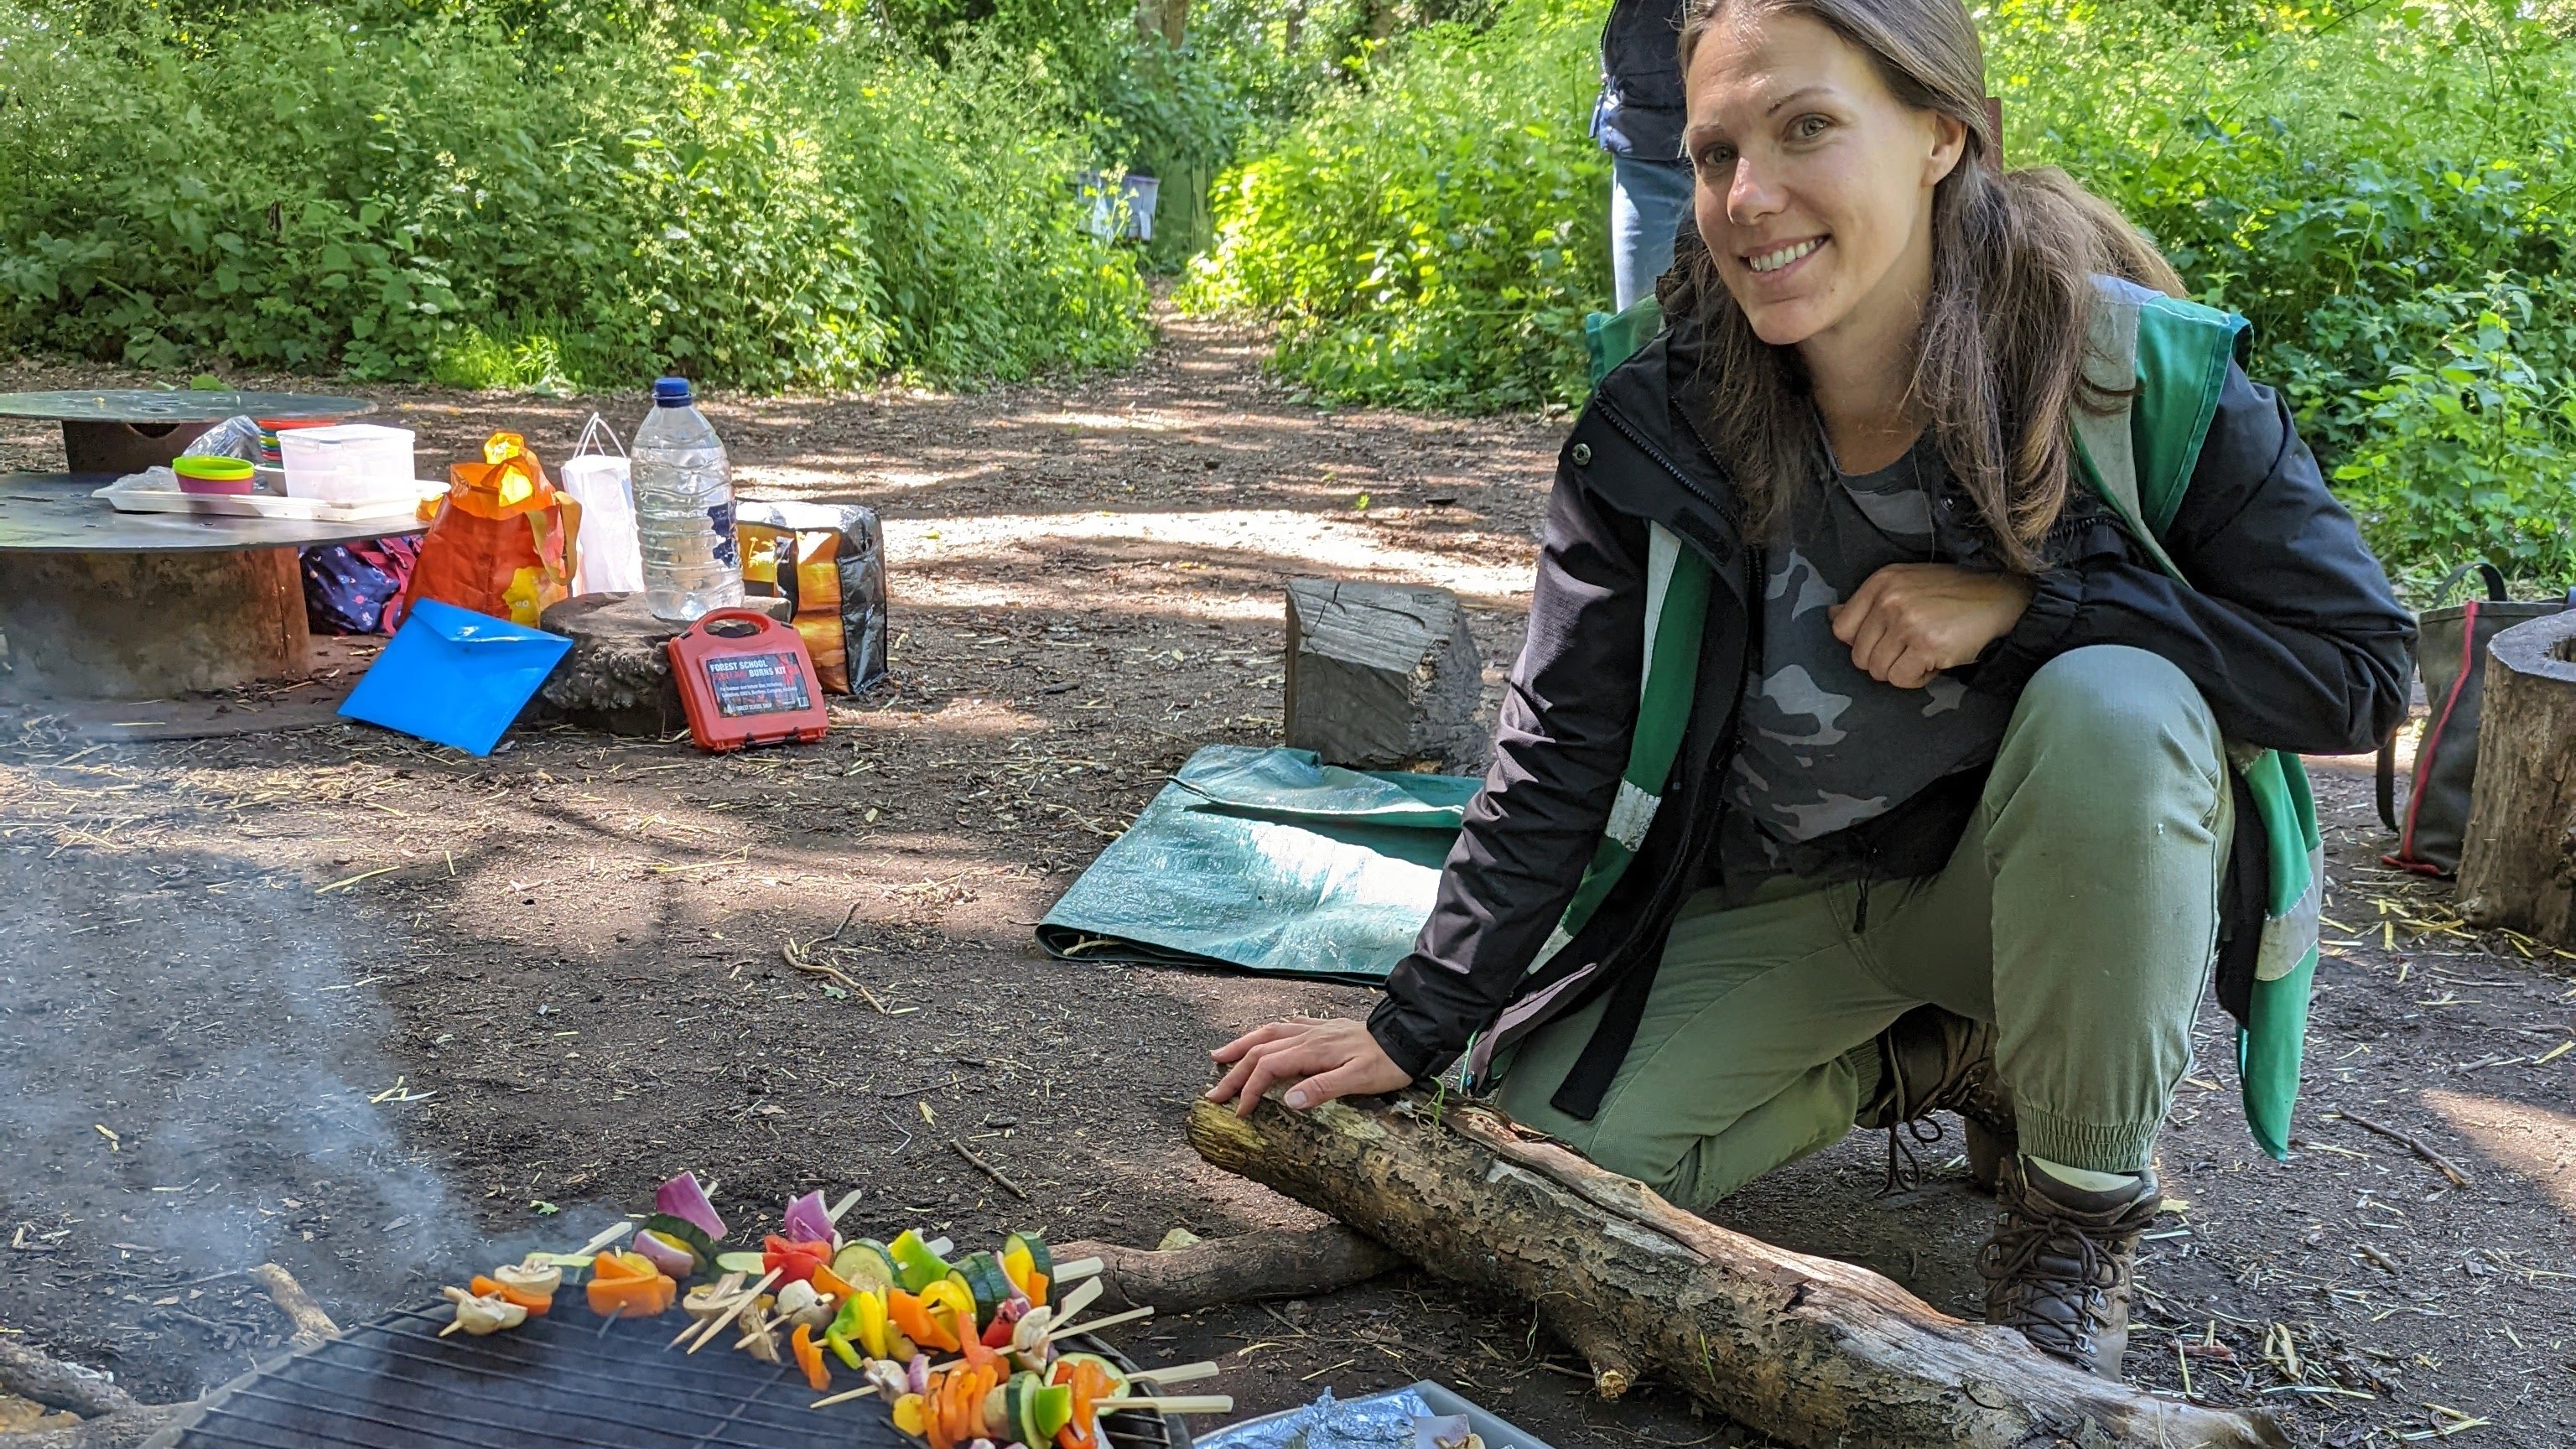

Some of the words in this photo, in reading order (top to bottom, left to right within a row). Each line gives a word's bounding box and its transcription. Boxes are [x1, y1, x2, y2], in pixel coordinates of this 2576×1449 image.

[710, 662, 738, 673] FOREST
[739, 660, 768, 670] SCHOOL
[749, 667, 774, 678] BURNS
[774, 666, 787, 675] KIT
